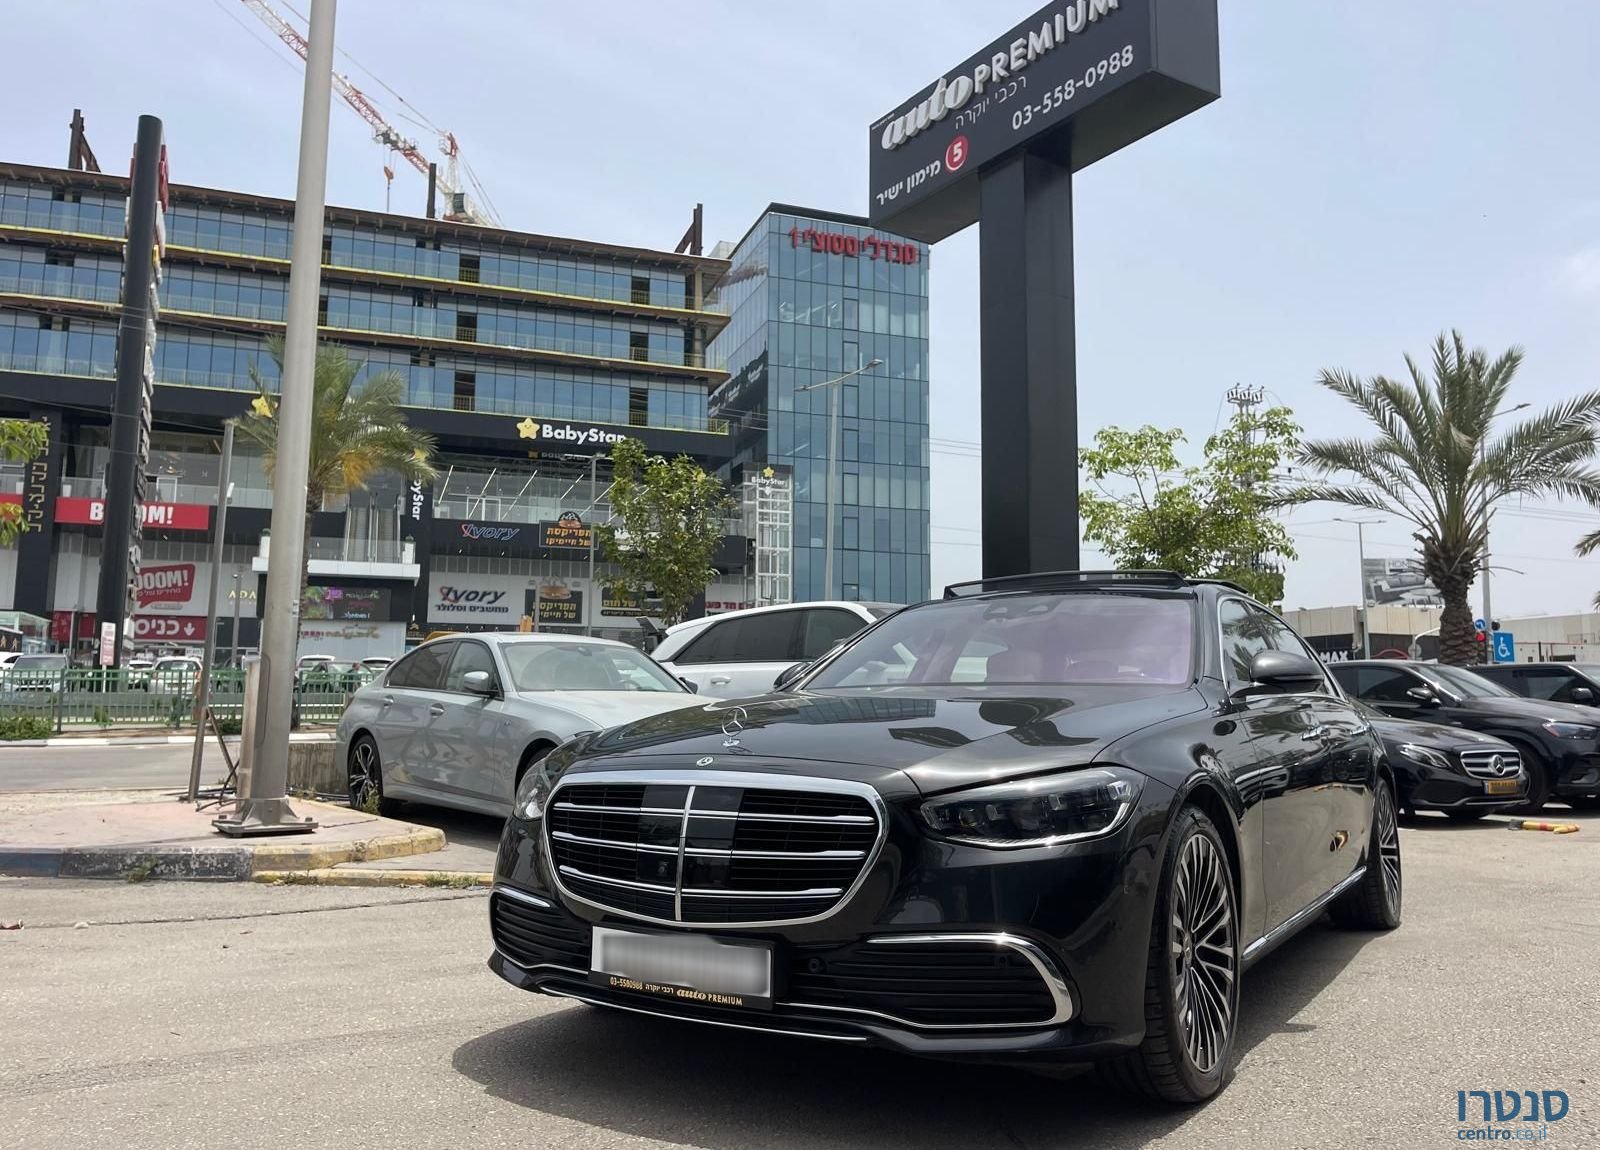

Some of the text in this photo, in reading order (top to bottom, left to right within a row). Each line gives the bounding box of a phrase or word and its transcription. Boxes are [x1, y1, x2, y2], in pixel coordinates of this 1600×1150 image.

[881, 0, 1119, 151] auto PREMIUM
[1012, 44, 1135, 131] 03-558-0988
[954, 76, 1028, 131] רכבי יוקרה
[906, 159, 941, 194] מימון
[876, 181, 904, 206] ישיר
[542, 424, 626, 445] BabyStar
[751, 476, 785, 486] BabyStar
[461, 523, 520, 541] Ivory
[439, 585, 506, 605] Ivory
[135, 619, 180, 636] כניס
[677, 989, 707, 1000] auto
[708, 993, 743, 1006] PREMIUM
